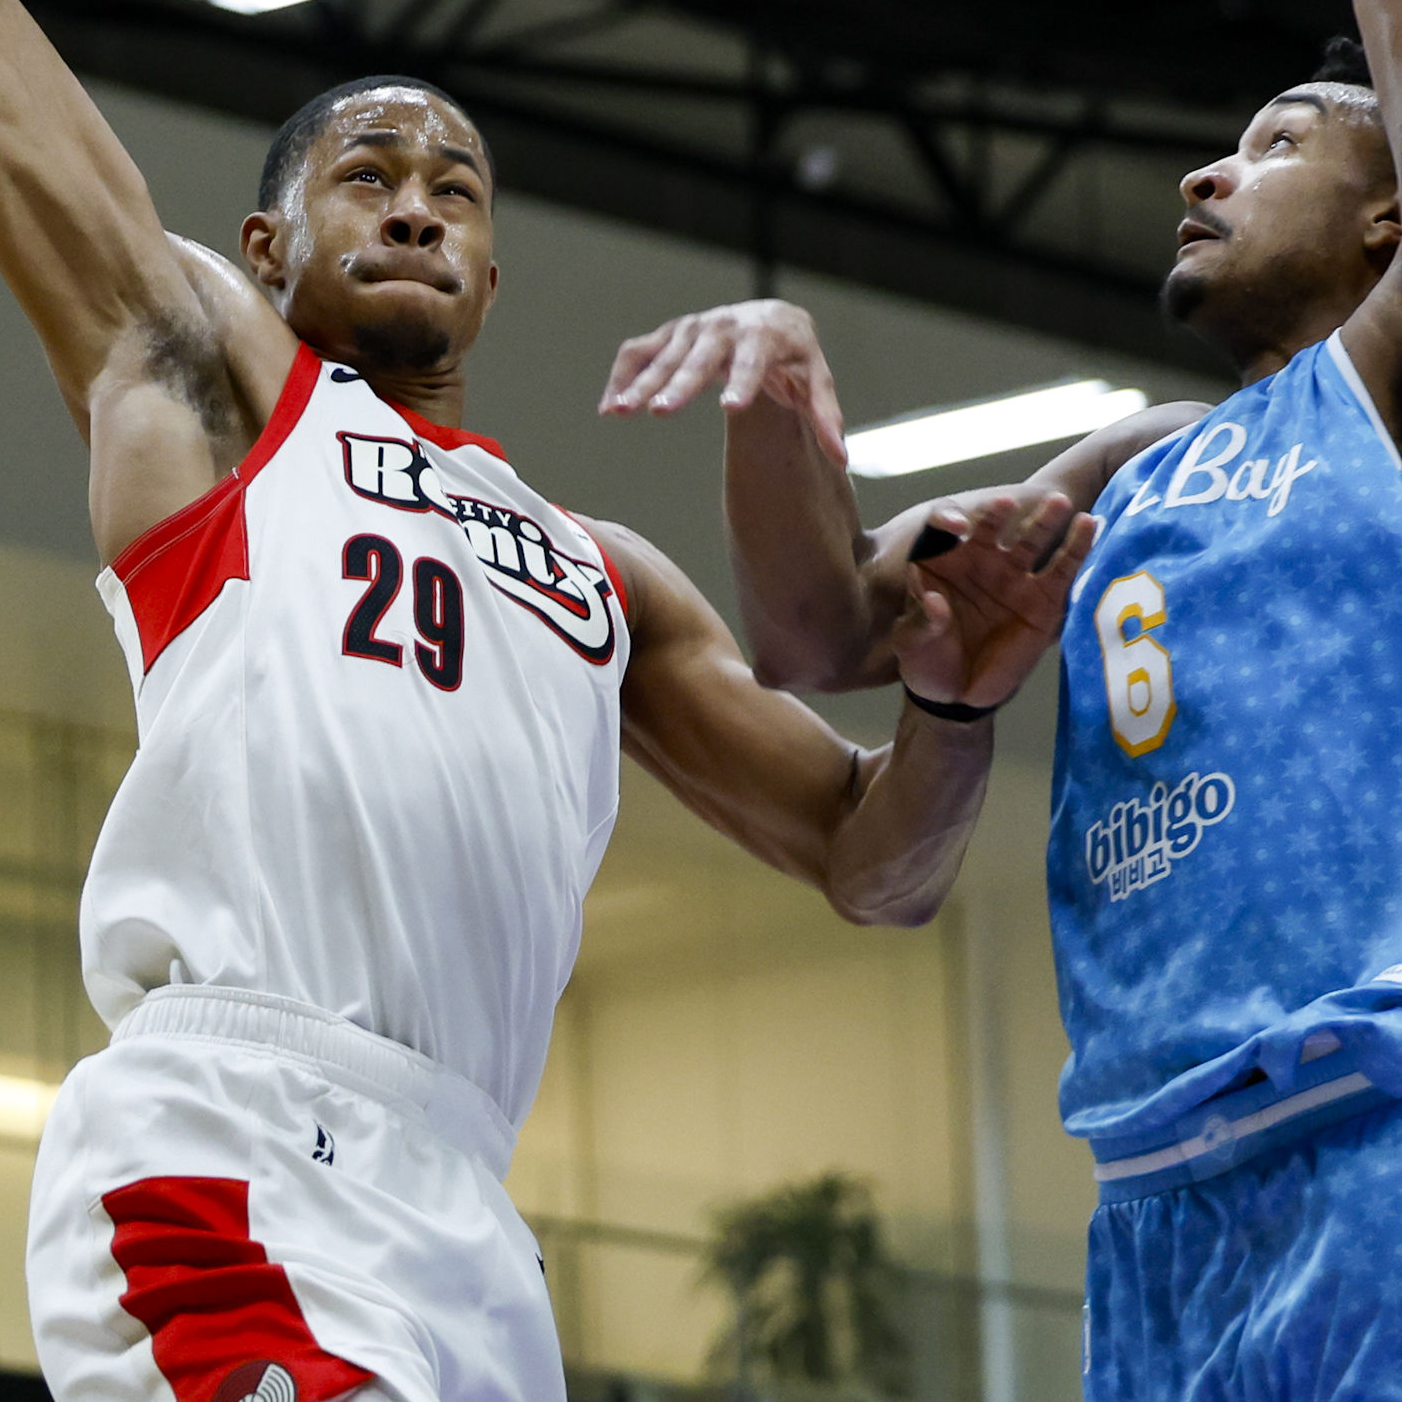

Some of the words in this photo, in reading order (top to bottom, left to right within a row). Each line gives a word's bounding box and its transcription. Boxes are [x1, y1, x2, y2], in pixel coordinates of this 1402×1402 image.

[1164, 421, 1318, 518] Bay
[341, 533, 465, 692] 29
[1093, 569, 1178, 758] 6
[1086, 772, 1236, 885] bibigo
[1108, 847, 1172, 902] 비비고
